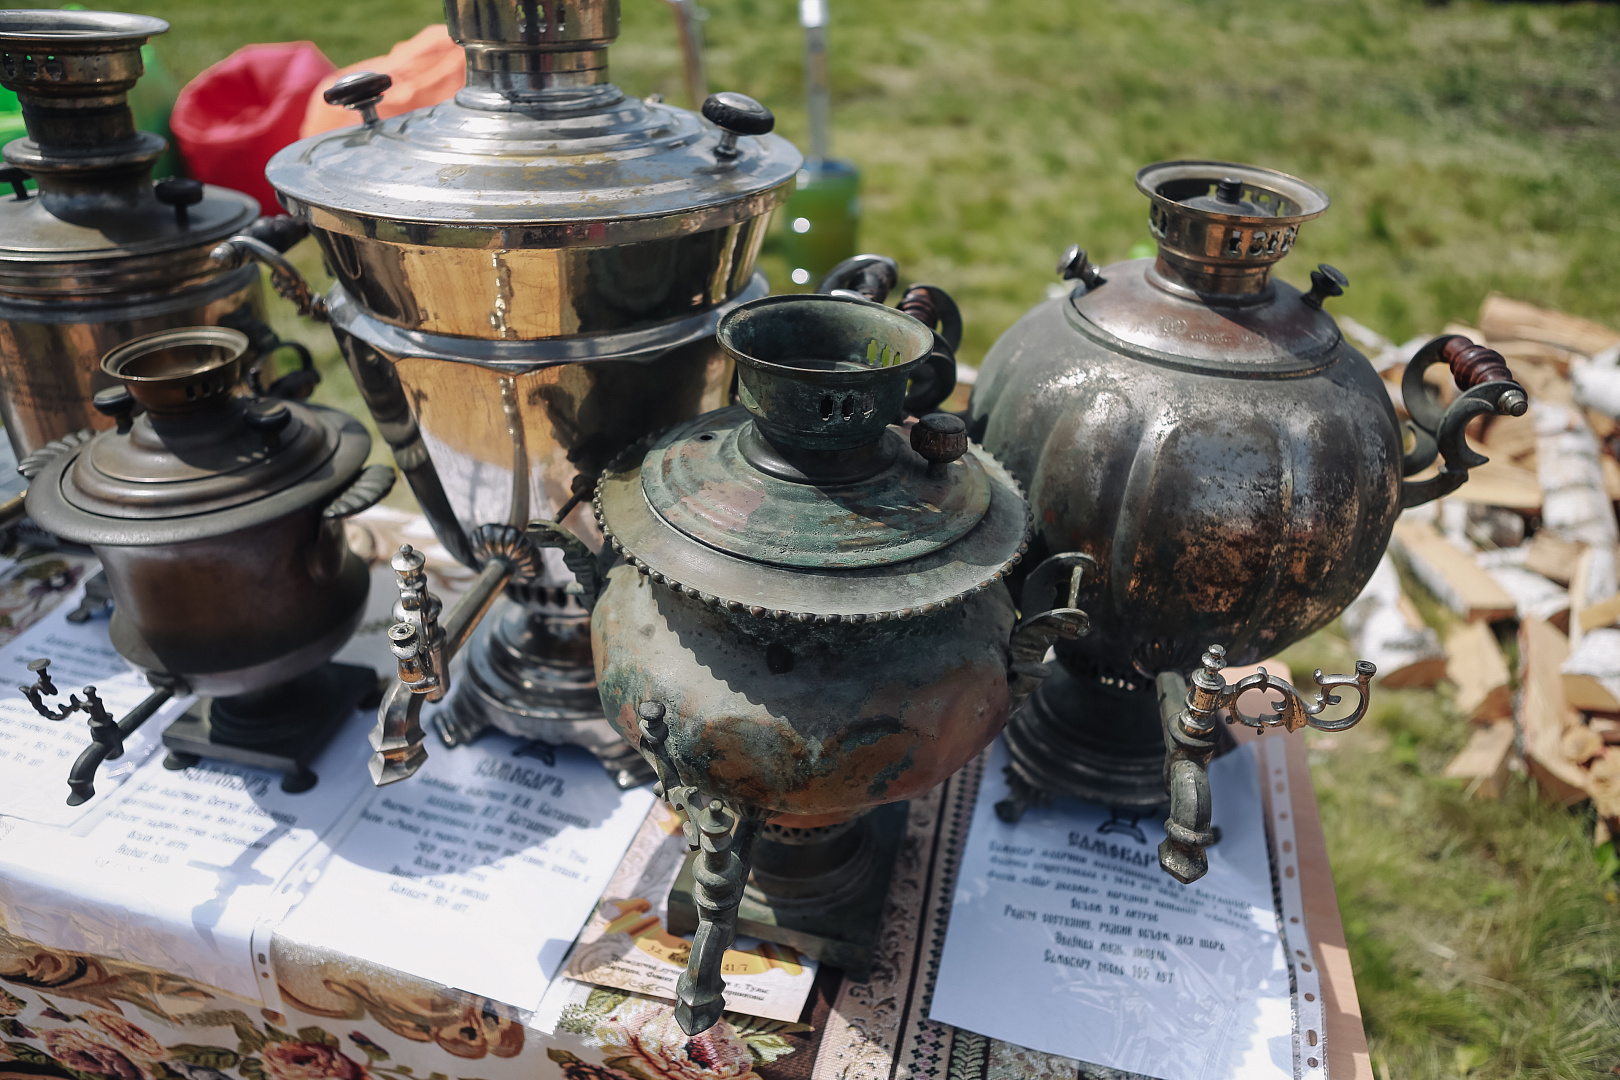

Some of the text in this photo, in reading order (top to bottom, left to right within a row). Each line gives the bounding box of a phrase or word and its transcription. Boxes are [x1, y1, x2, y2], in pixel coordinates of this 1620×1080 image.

[1068, 830, 1159, 868] САМОВАР
[723, 963, 748, 971] 41/7
[1154, 970, 1176, 984] лет
